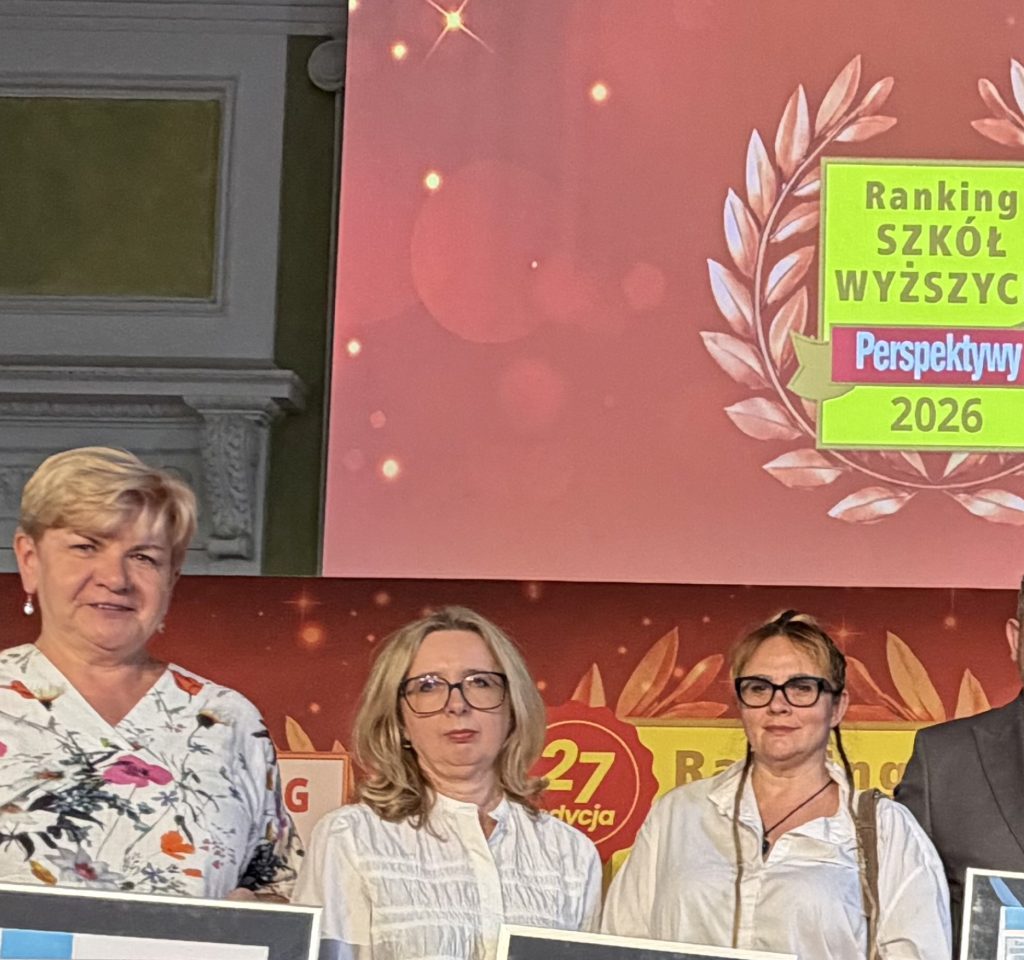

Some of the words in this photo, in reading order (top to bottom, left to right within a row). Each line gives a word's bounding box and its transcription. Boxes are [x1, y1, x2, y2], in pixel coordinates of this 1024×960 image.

[865, 181, 1018, 220] Ranking
[877, 216, 1007, 257] SZKÓŁ
[855, 331, 1023, 381] Perspektywy
[890, 397, 984, 433] 2026
[541, 738, 616, 804] 27
